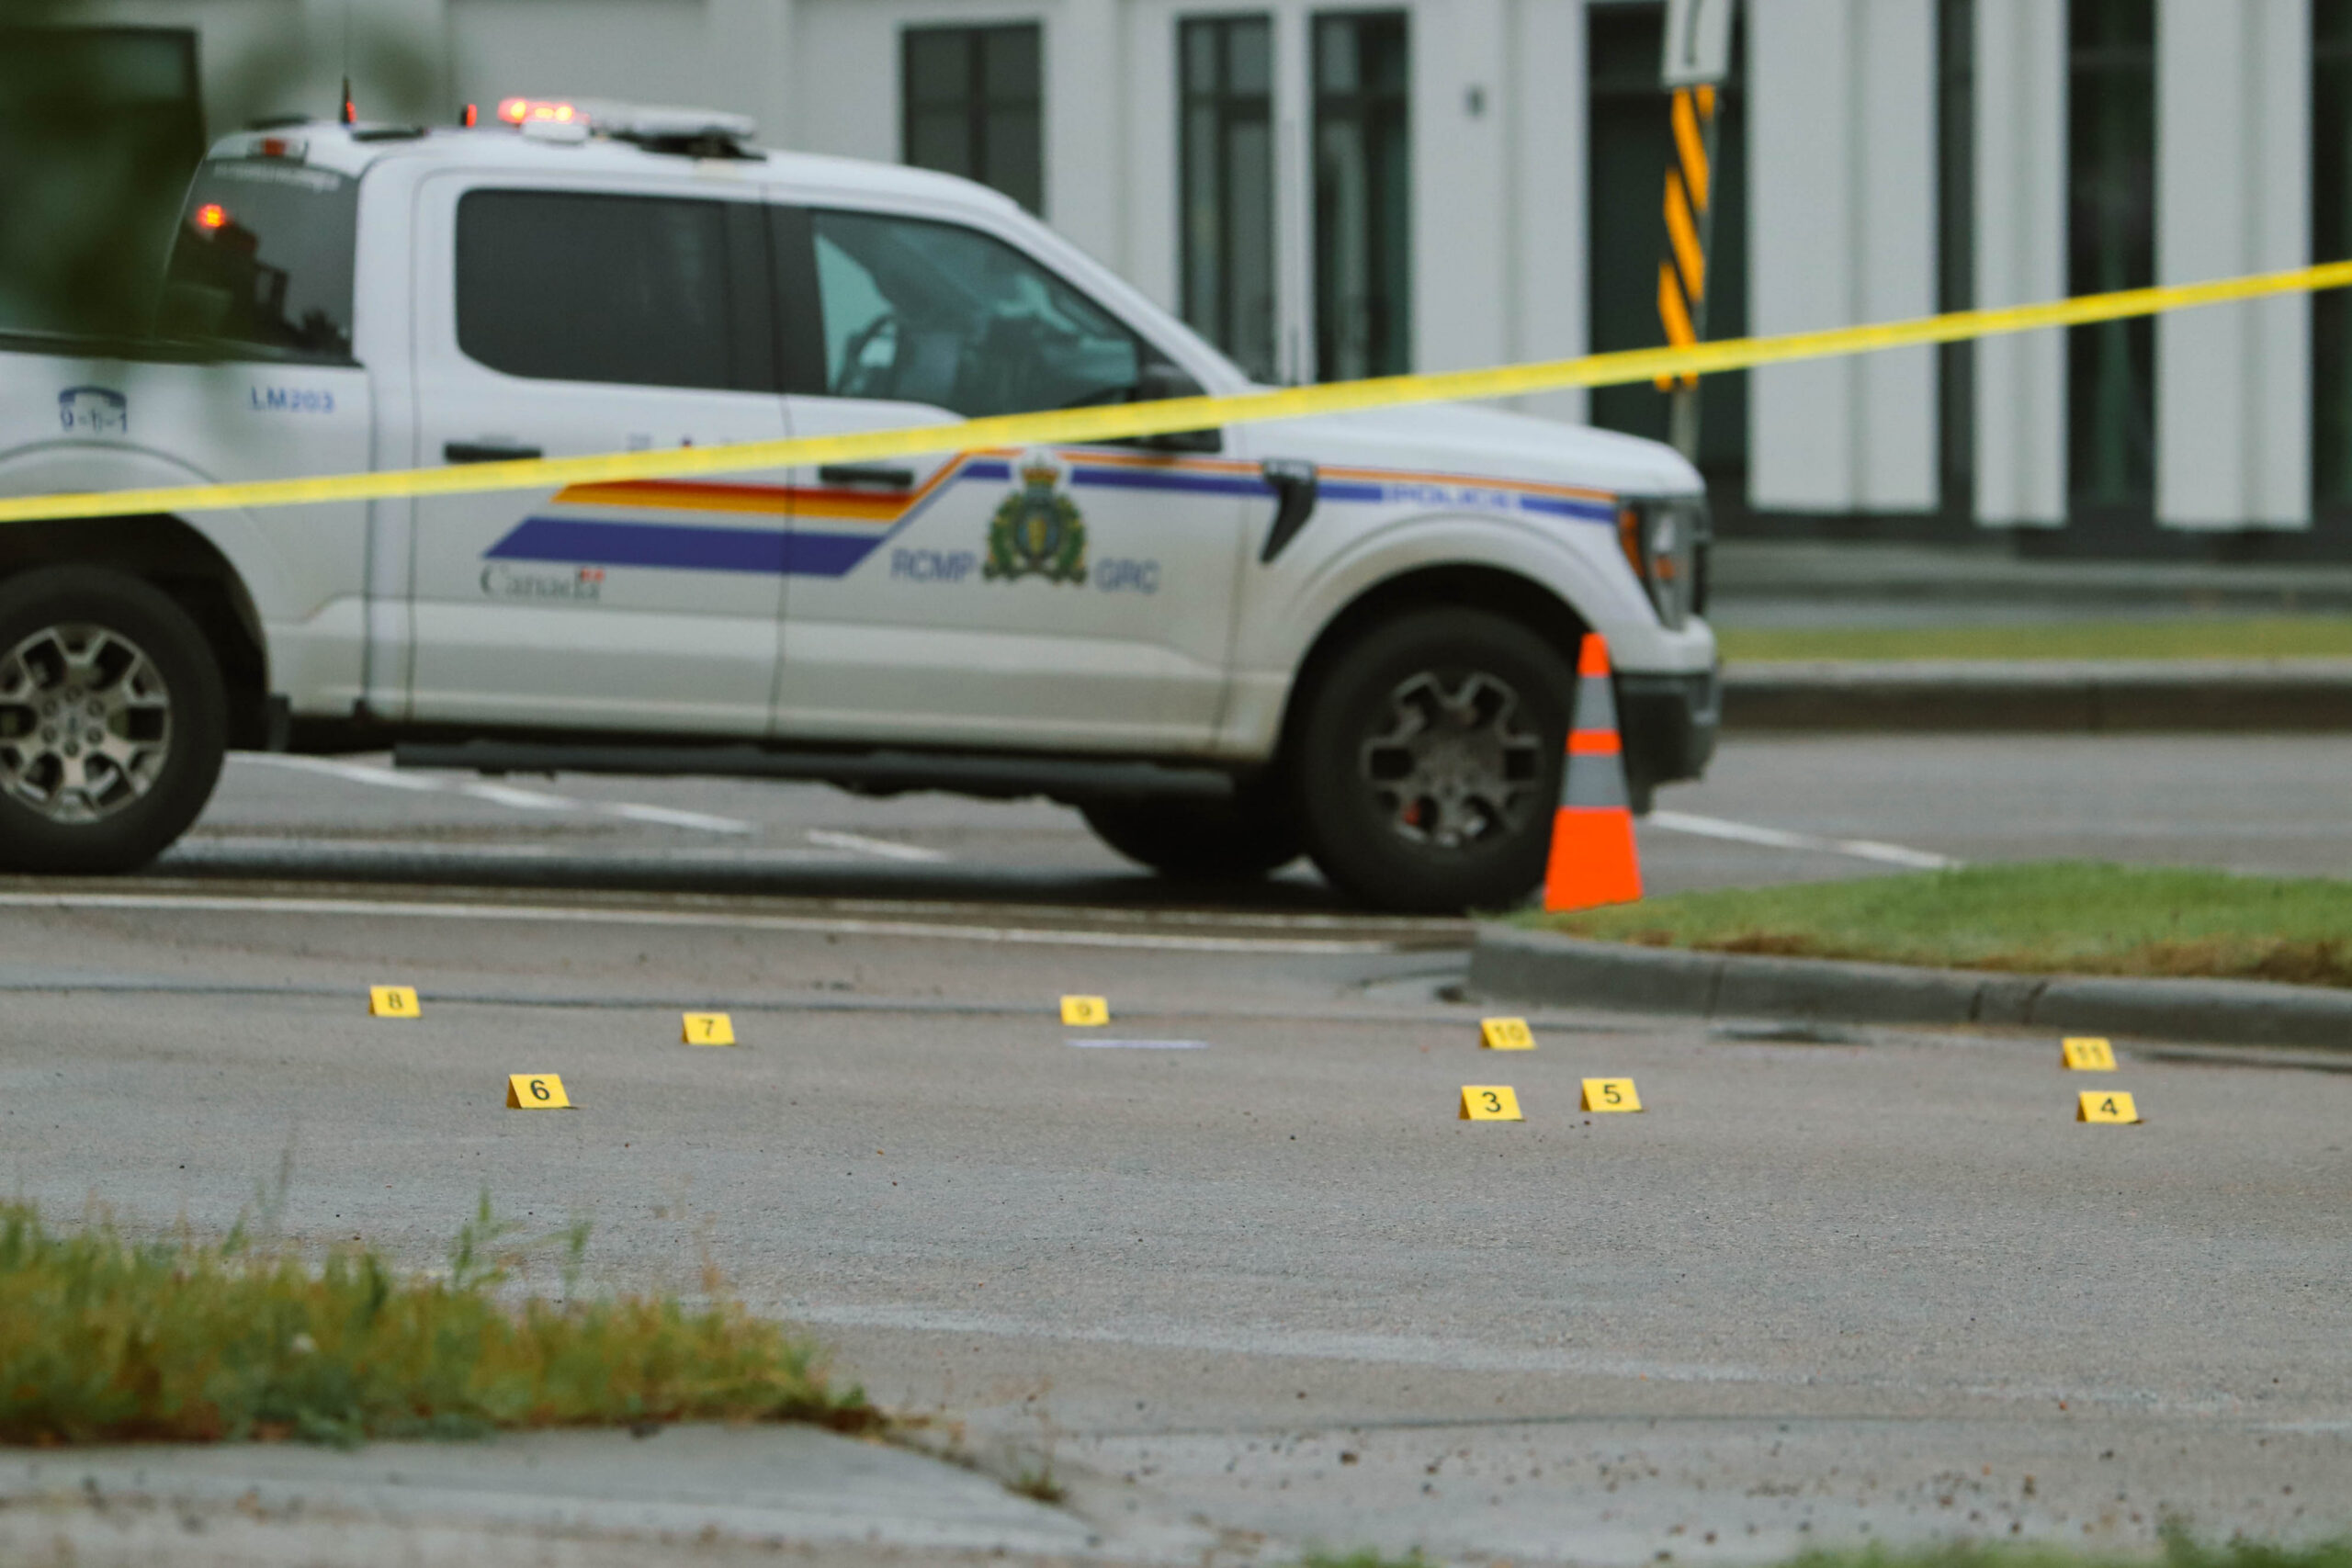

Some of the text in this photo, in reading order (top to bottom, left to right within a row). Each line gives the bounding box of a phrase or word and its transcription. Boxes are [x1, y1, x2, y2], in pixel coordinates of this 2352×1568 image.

[890, 548, 978, 582] RCMP
[480, 563, 600, 600] Canada
[387, 991, 404, 1010] 8
[699, 1018, 716, 1038] 7
[1493, 1023, 1527, 1042] 10
[529, 1078, 551, 1101] 6
[1602, 1083, 1623, 1105] 5
[1480, 1090, 1503, 1114] 3
[2099, 1097, 2119, 1117] 4
